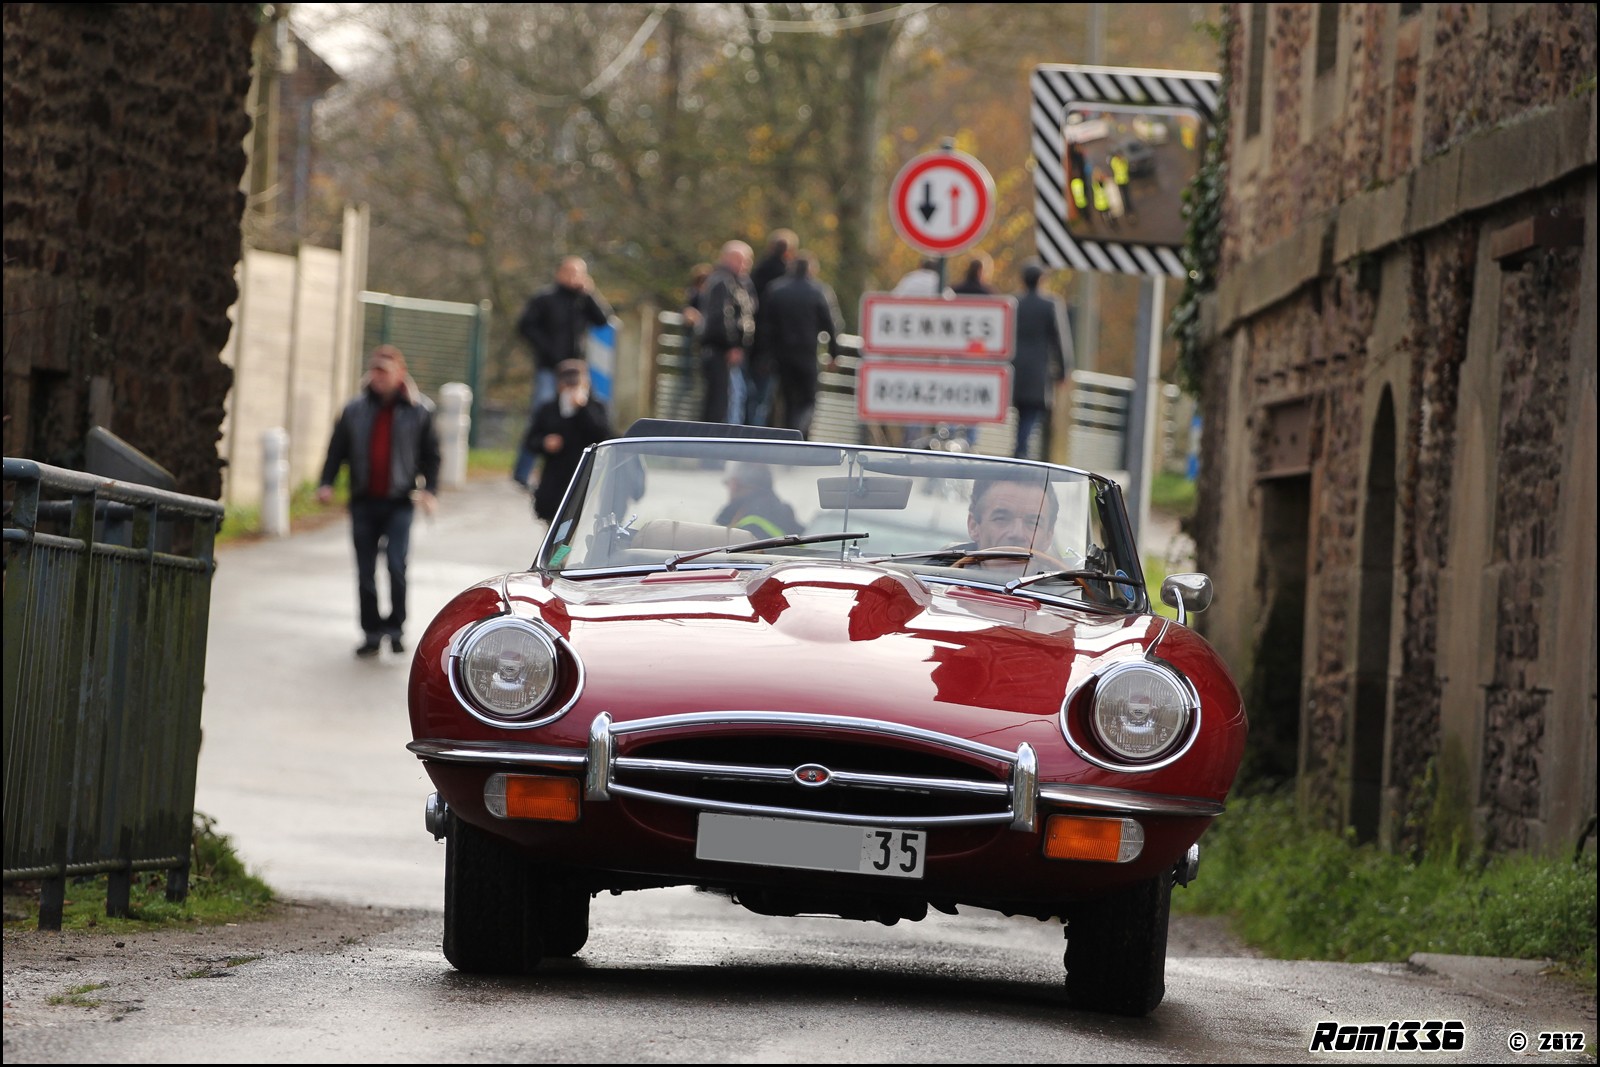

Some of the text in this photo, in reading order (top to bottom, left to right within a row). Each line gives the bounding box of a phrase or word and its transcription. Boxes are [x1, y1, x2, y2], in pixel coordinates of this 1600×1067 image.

[878, 312, 994, 338] RENNES
[874, 378, 992, 405] ROAZHON
[873, 830, 919, 873] 35
